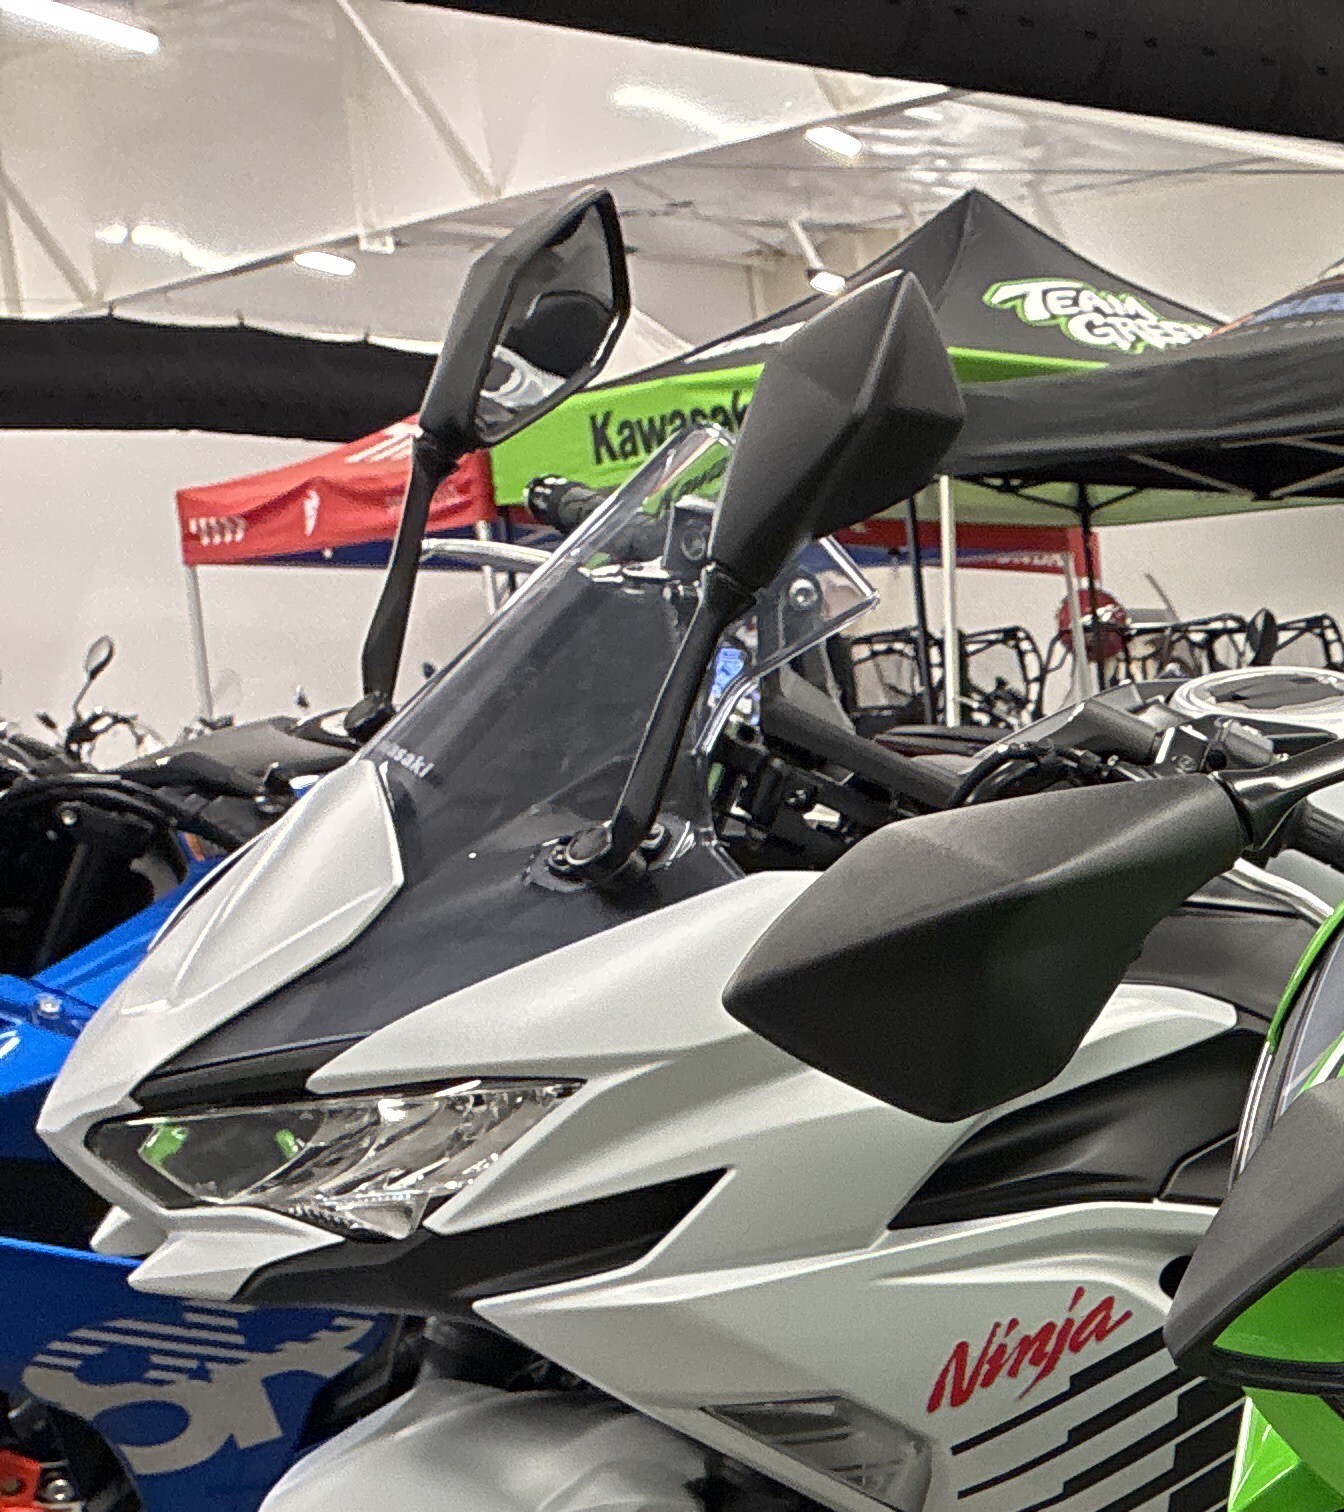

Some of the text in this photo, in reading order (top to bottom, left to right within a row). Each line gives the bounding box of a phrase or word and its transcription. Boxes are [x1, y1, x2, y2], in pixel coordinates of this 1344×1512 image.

[990, 280, 1158, 322] TEAM
[589, 389, 750, 465] Kawaak
[926, 1286, 1133, 1413] Ninja
